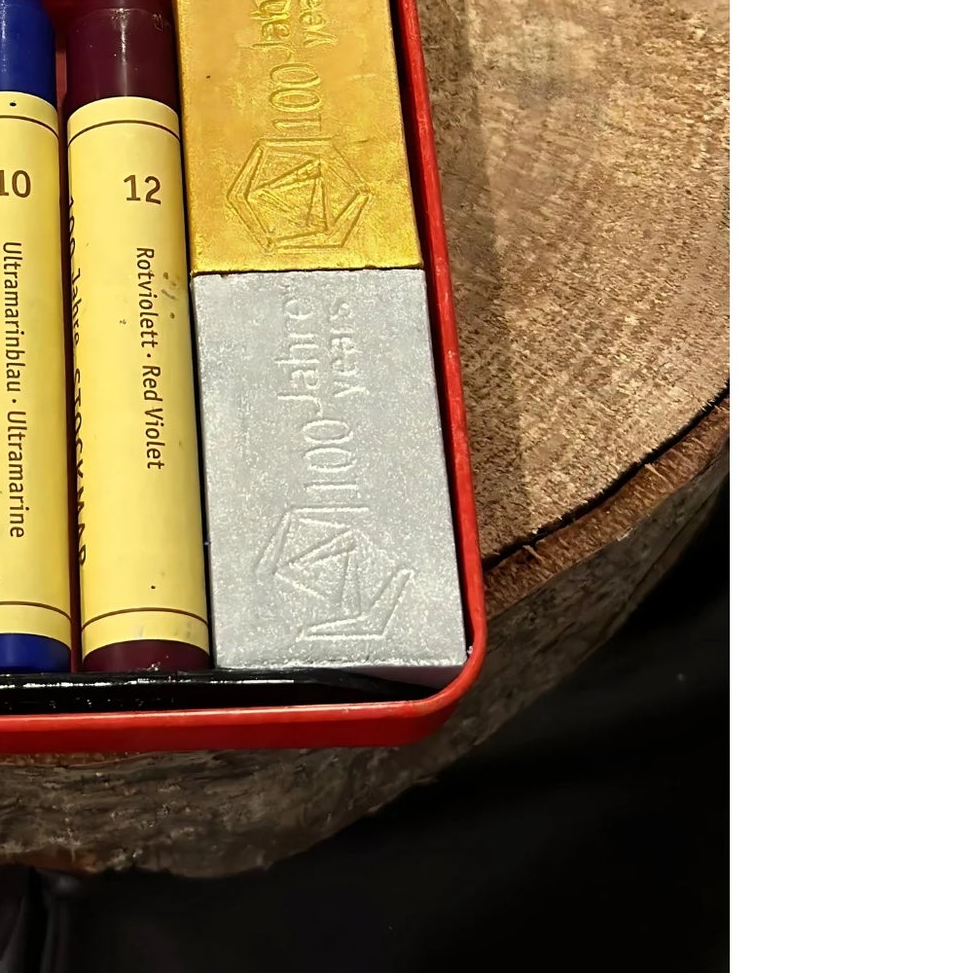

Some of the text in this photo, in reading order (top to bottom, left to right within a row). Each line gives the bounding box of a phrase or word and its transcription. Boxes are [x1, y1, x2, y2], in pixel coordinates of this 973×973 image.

[269, 61, 321, 132] 100
[123, 174, 162, 205] 12
[3, 241, 30, 538] Ultramarinblau Ultramarine
[136, 246, 166, 470] Rotviolett Red Violet
[329, 300, 369, 398] years
[302, 417, 360, 498] 100
